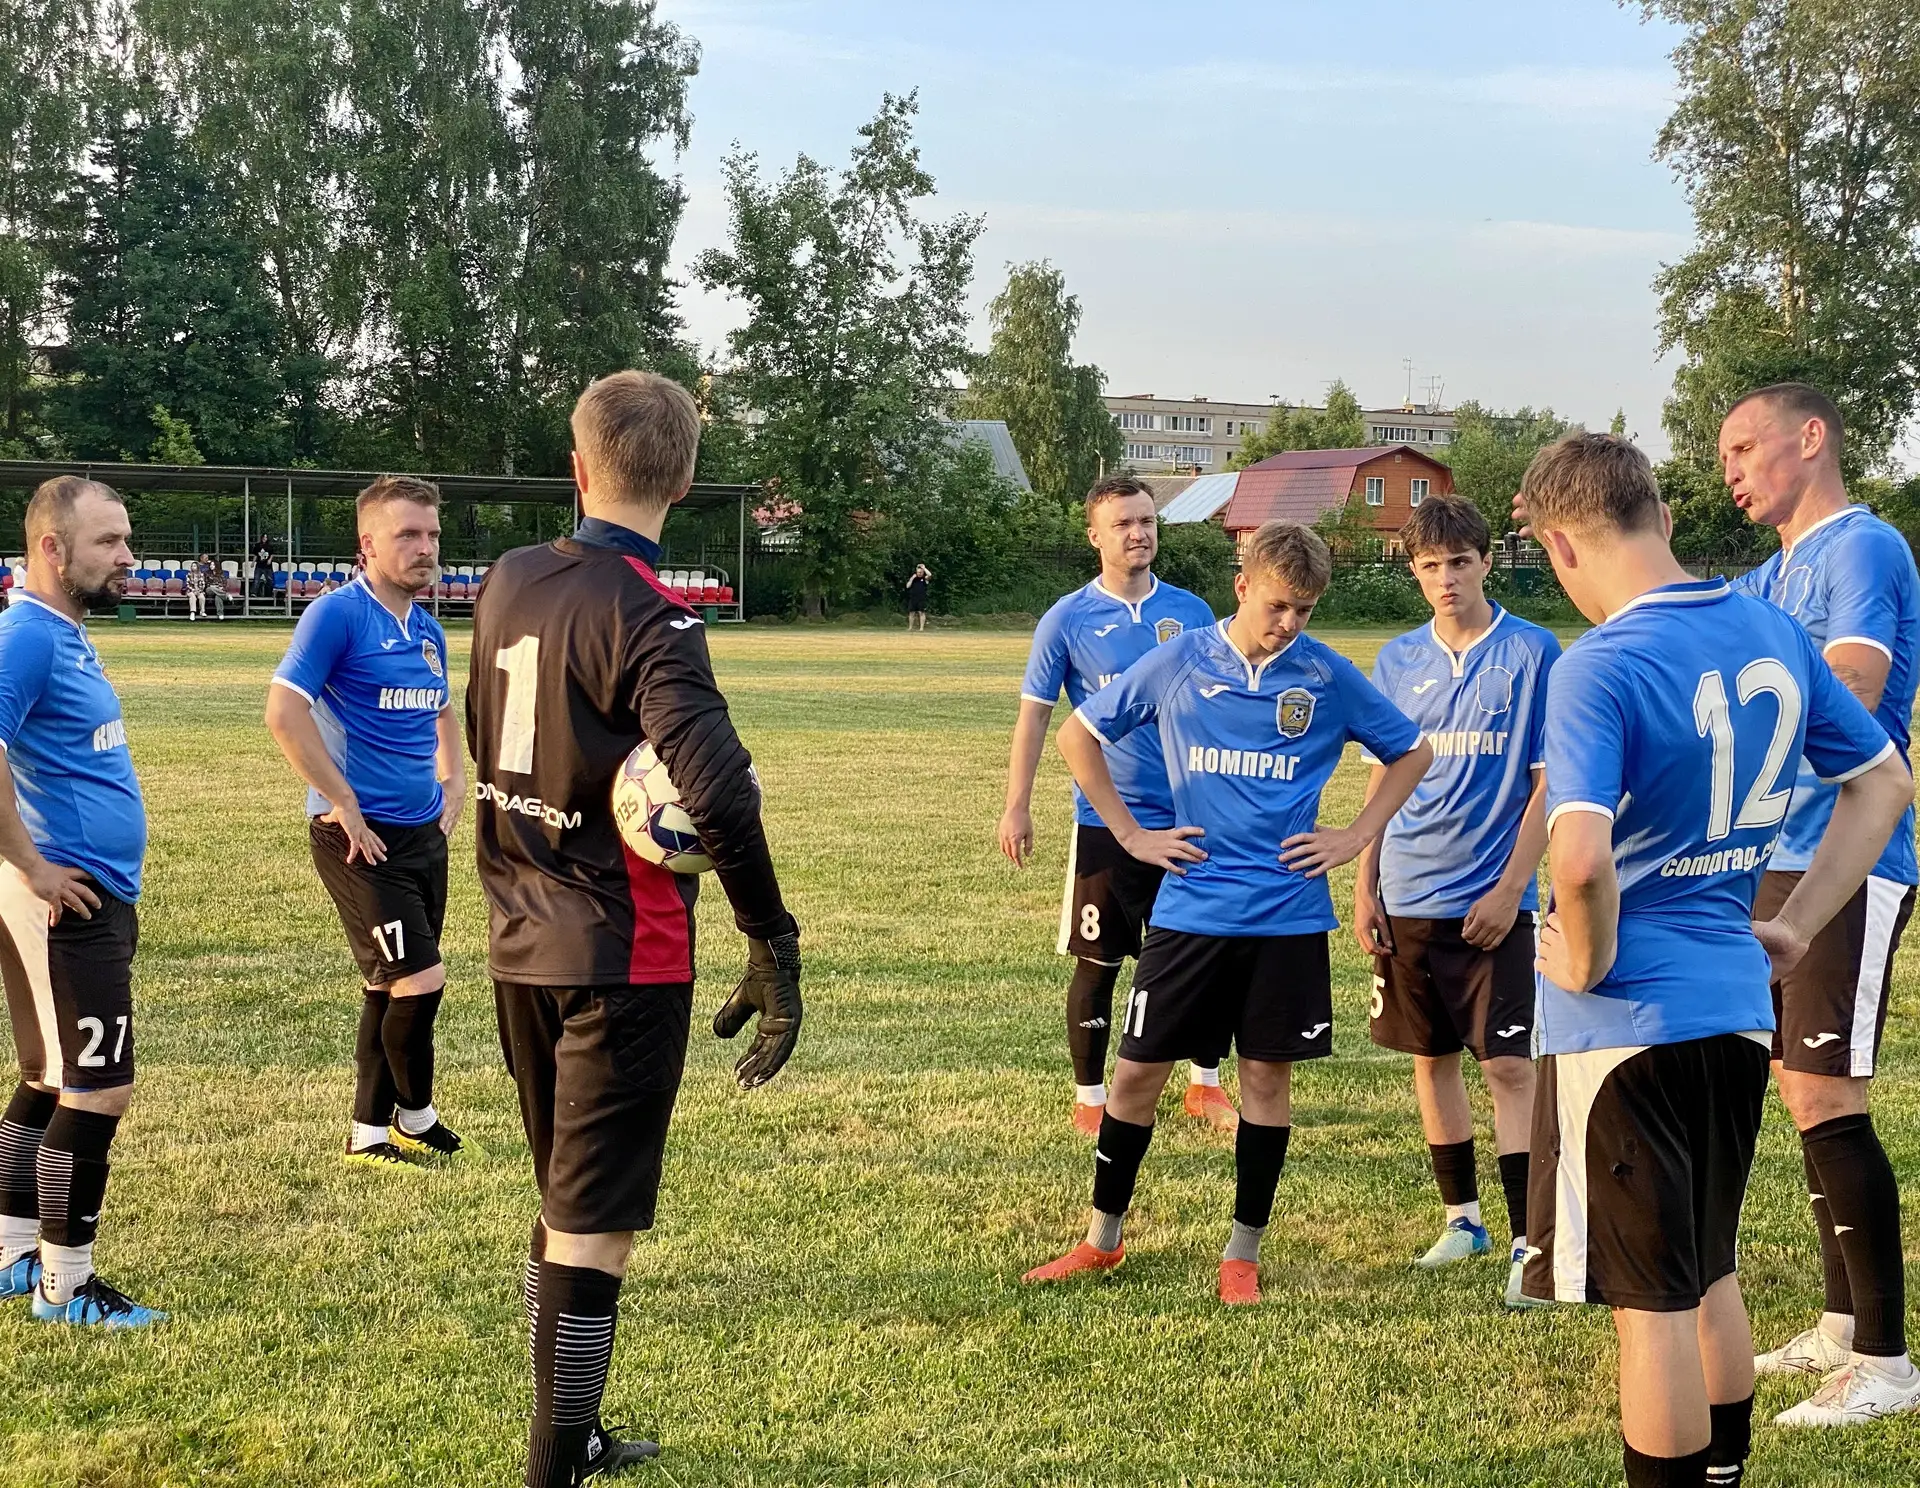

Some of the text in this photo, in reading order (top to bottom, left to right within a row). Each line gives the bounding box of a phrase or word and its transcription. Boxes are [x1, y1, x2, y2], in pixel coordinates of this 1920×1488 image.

[496, 635, 539, 775] 1
[1188, 746, 1301, 781] КОМПРАГ
[1427, 731, 1508, 757] ОМПРАГ
[1693, 657, 1802, 842] 12
[372, 919, 405, 963] 17
[1080, 903, 1101, 941] 8
[1370, 973, 1386, 1019] 5
